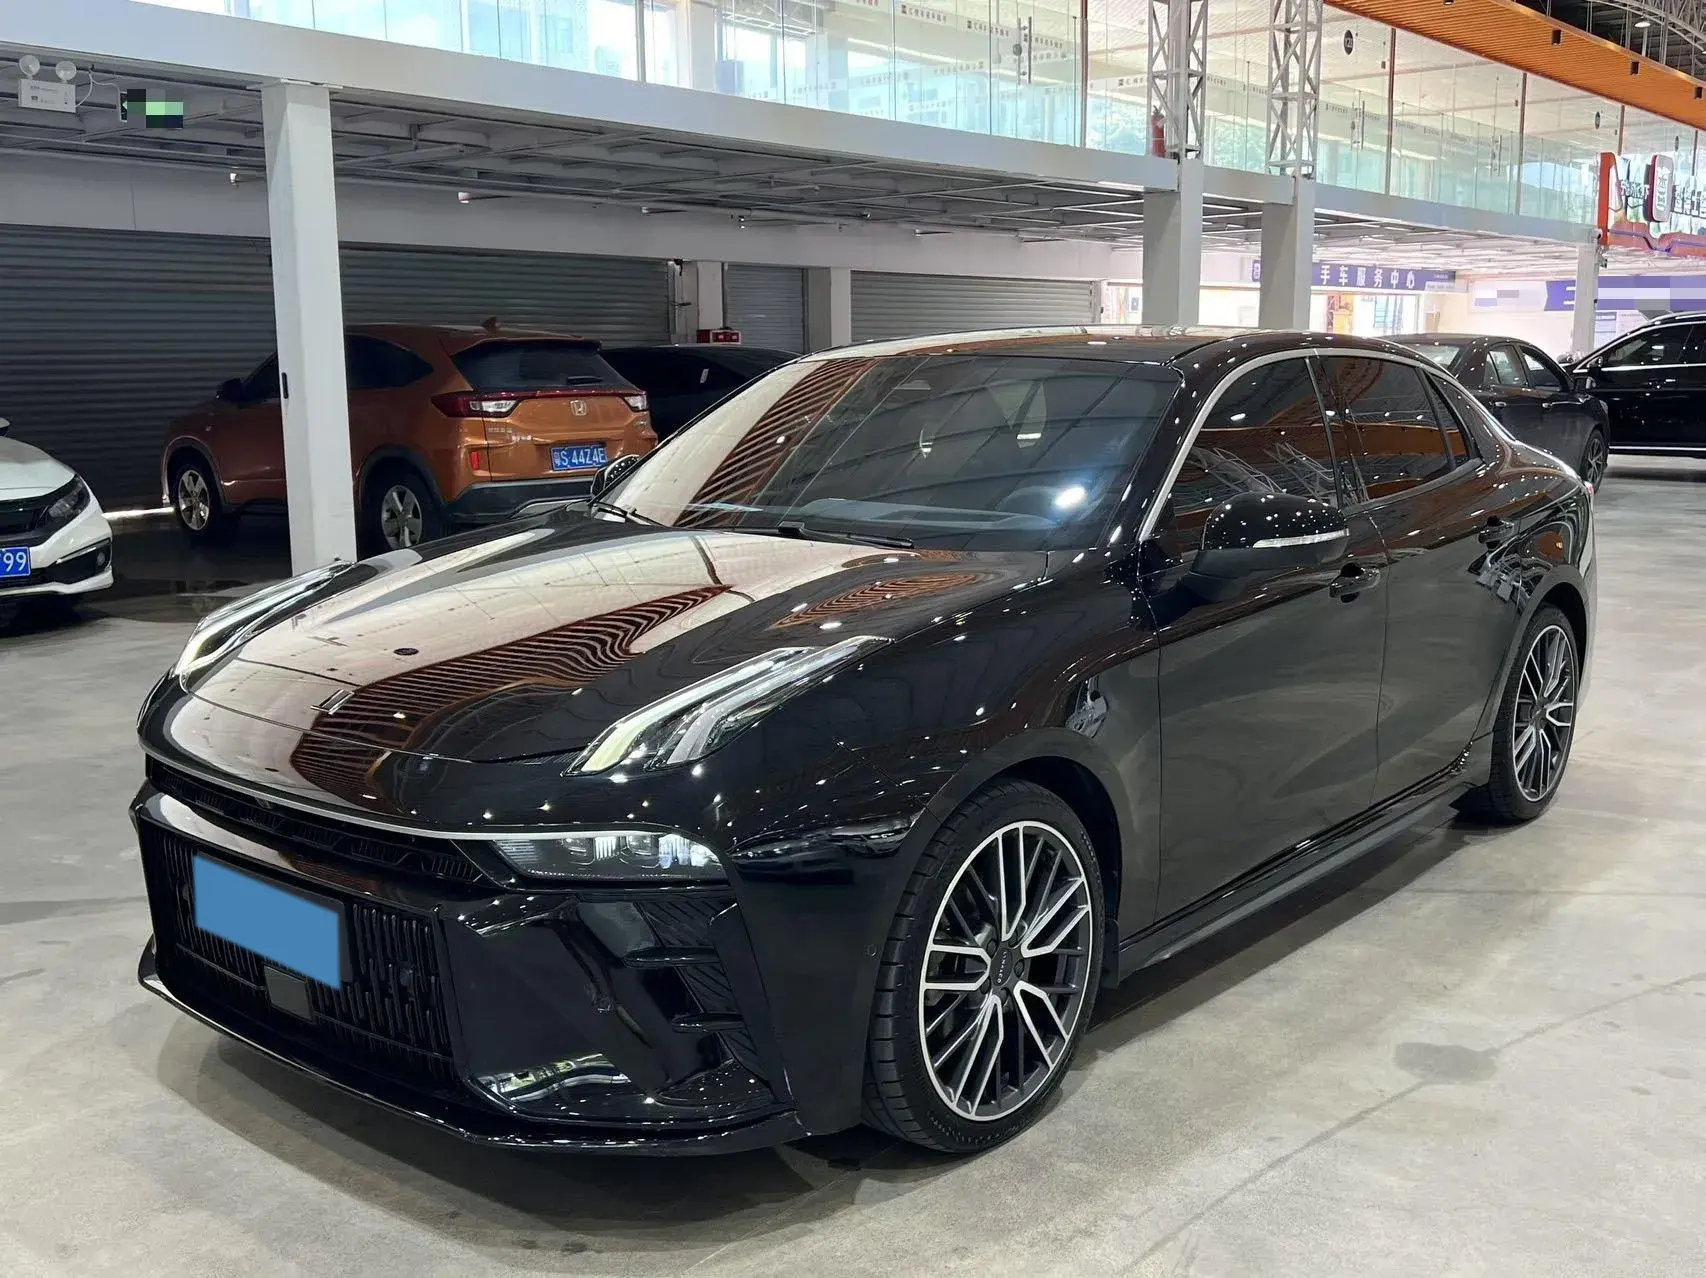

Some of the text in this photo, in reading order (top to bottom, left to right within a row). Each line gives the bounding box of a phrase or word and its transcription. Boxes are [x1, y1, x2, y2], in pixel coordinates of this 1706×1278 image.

[1319, 264, 1416, 289] 手车服务中心
